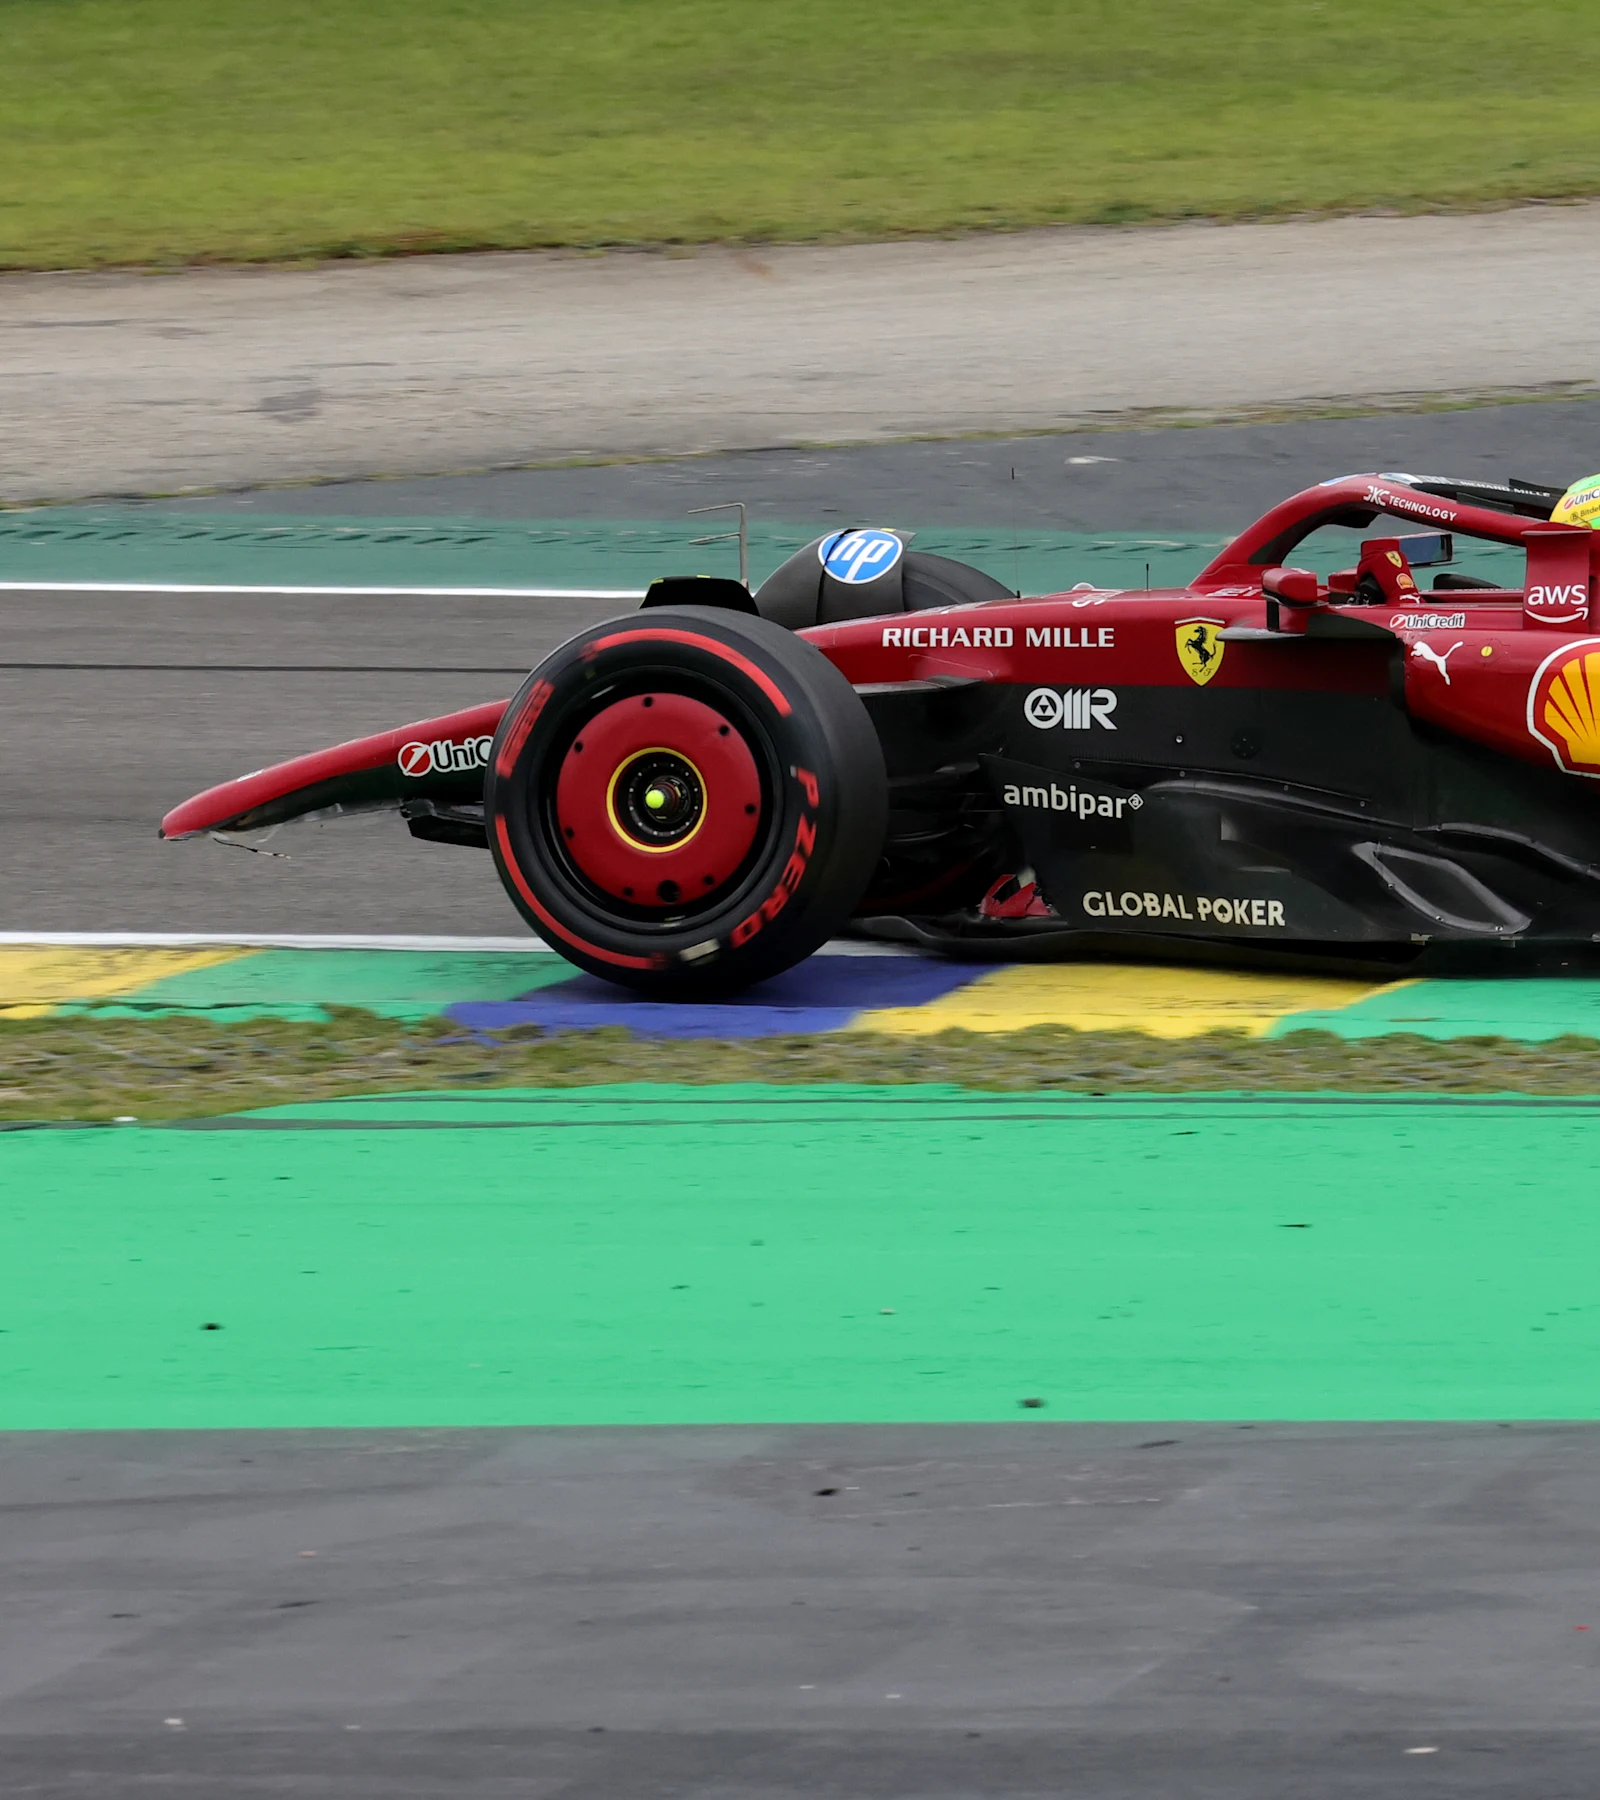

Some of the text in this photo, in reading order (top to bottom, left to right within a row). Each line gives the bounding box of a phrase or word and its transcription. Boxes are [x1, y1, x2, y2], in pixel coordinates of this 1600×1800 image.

[1389, 495, 1457, 521] TECHNOLOGY
[827, 529, 895, 581] hp
[1527, 584, 1587, 606] aws
[1405, 613, 1465, 629] UniCredit
[881, 626, 1115, 649] RICHARD MILLE
[1003, 783, 1127, 820] ambipar
[1082, 891, 1286, 927] GLOBAL POKER
